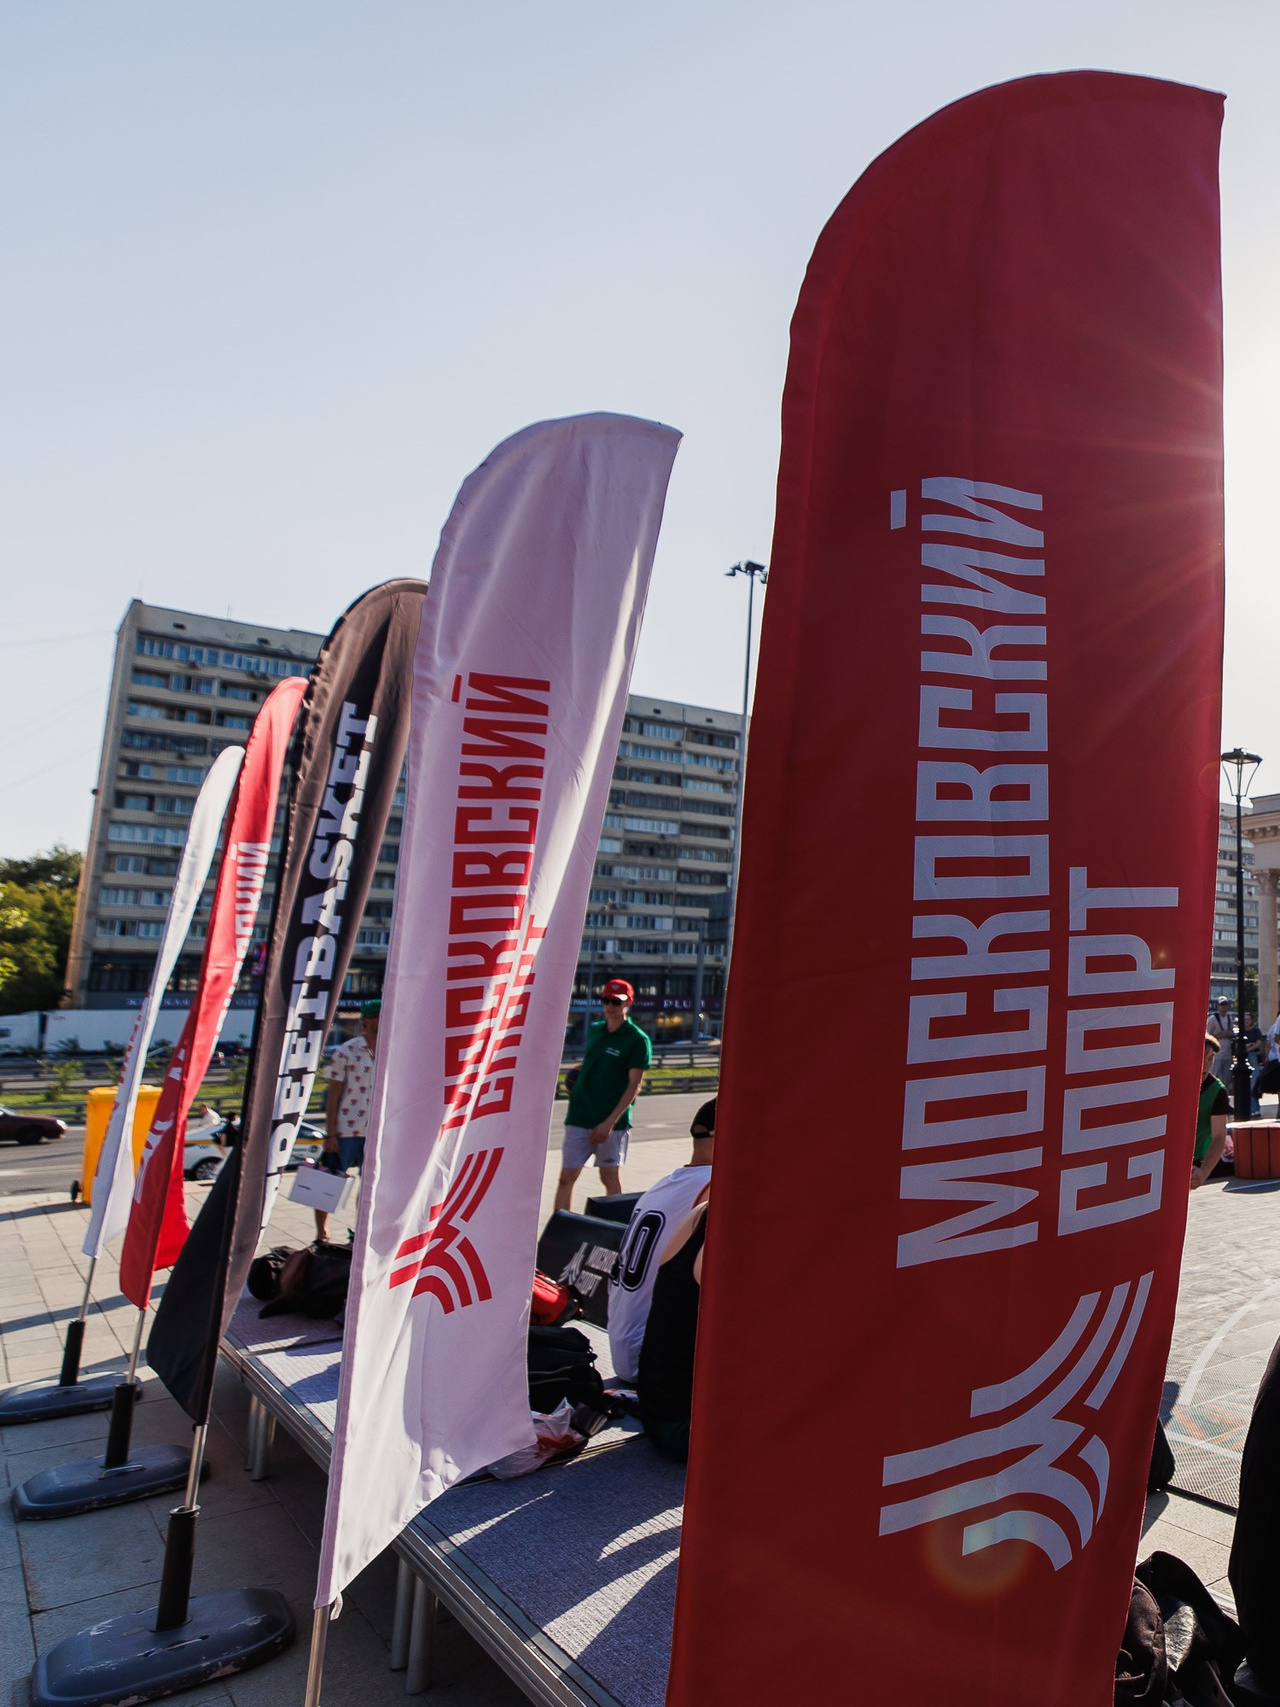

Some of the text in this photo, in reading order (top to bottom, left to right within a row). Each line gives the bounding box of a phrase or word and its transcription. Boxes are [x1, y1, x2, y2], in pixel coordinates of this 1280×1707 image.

[470, 914, 548, 1121] СПОРТ
[890, 476, 1050, 1269] МОСКОВСКИЙ
[1058, 867, 1180, 1237] СПОРТ
